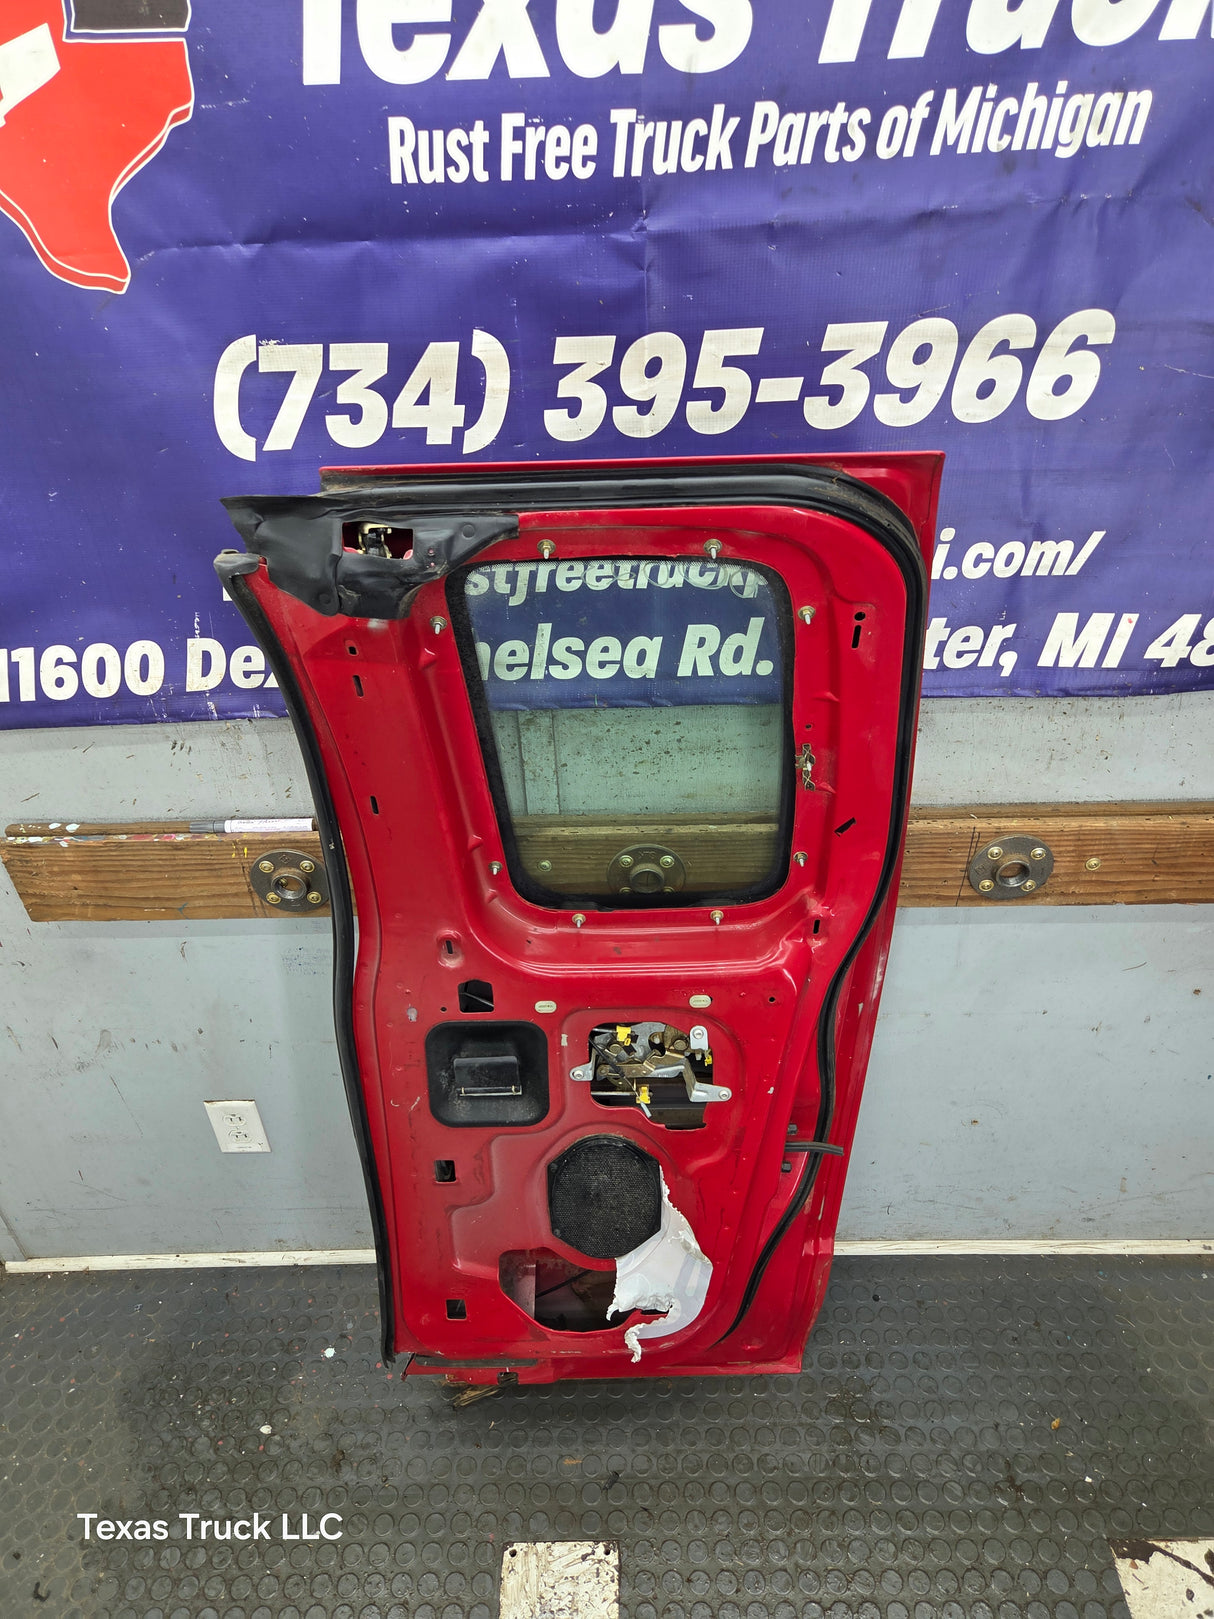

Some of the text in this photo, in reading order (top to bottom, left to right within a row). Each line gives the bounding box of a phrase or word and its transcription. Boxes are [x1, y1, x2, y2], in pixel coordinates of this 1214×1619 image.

[388, 80, 1153, 184] Rust Free Truck Parts of Michigan
[213, 308, 1116, 462] (734) 395-3966
[186, 637, 280, 692] De
[677, 616, 774, 677] Rd.
[1037, 612, 1140, 668] MI
